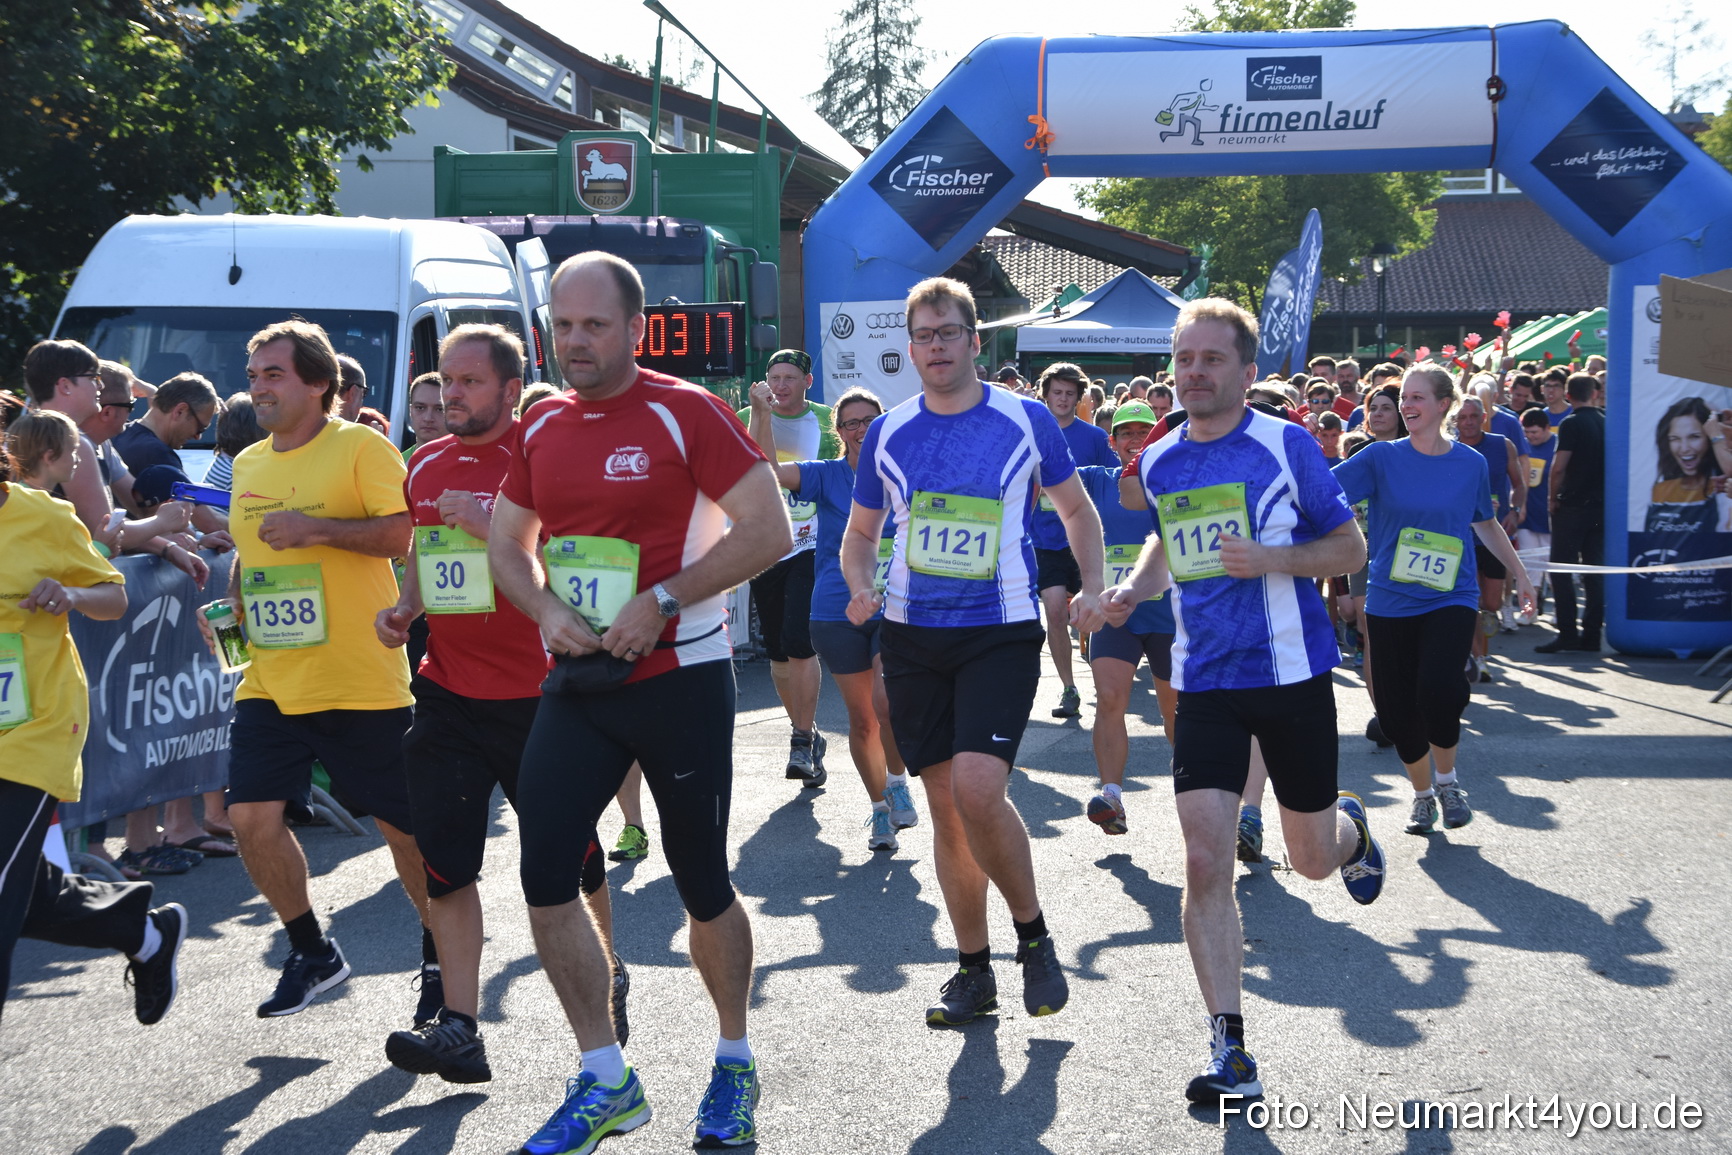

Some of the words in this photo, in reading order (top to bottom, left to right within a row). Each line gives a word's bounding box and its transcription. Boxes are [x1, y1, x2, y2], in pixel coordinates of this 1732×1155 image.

[1263, 74, 1317, 85] Fischer
[1220, 99, 1387, 133] firmenlauf
[1218, 133, 1287, 145] neumarkt
[1591, 148, 1617, 161] das
[906, 169, 993, 187] Fischer
[914, 187, 985, 196] AUTOMOBILE
[592, 195, 618, 206] 1628
[1060, 335, 1173, 345] www.fischer-automobi
[884, 356, 899, 369] FIAT
[244, 501, 284, 513] Seniorenstift
[918, 525, 987, 558] 1121
[1173, 519, 1241, 556] 1123
[929, 557, 951, 565] Matthias
[1191, 559, 1210, 567] Johann
[1408, 551, 1447, 575] 715
[435, 561, 465, 589] 30
[568, 575, 599, 609] 31
[250, 598, 317, 627] 1338
[125, 652, 242, 730] Fischer
[145, 724, 232, 769] AUTOMOBILE
